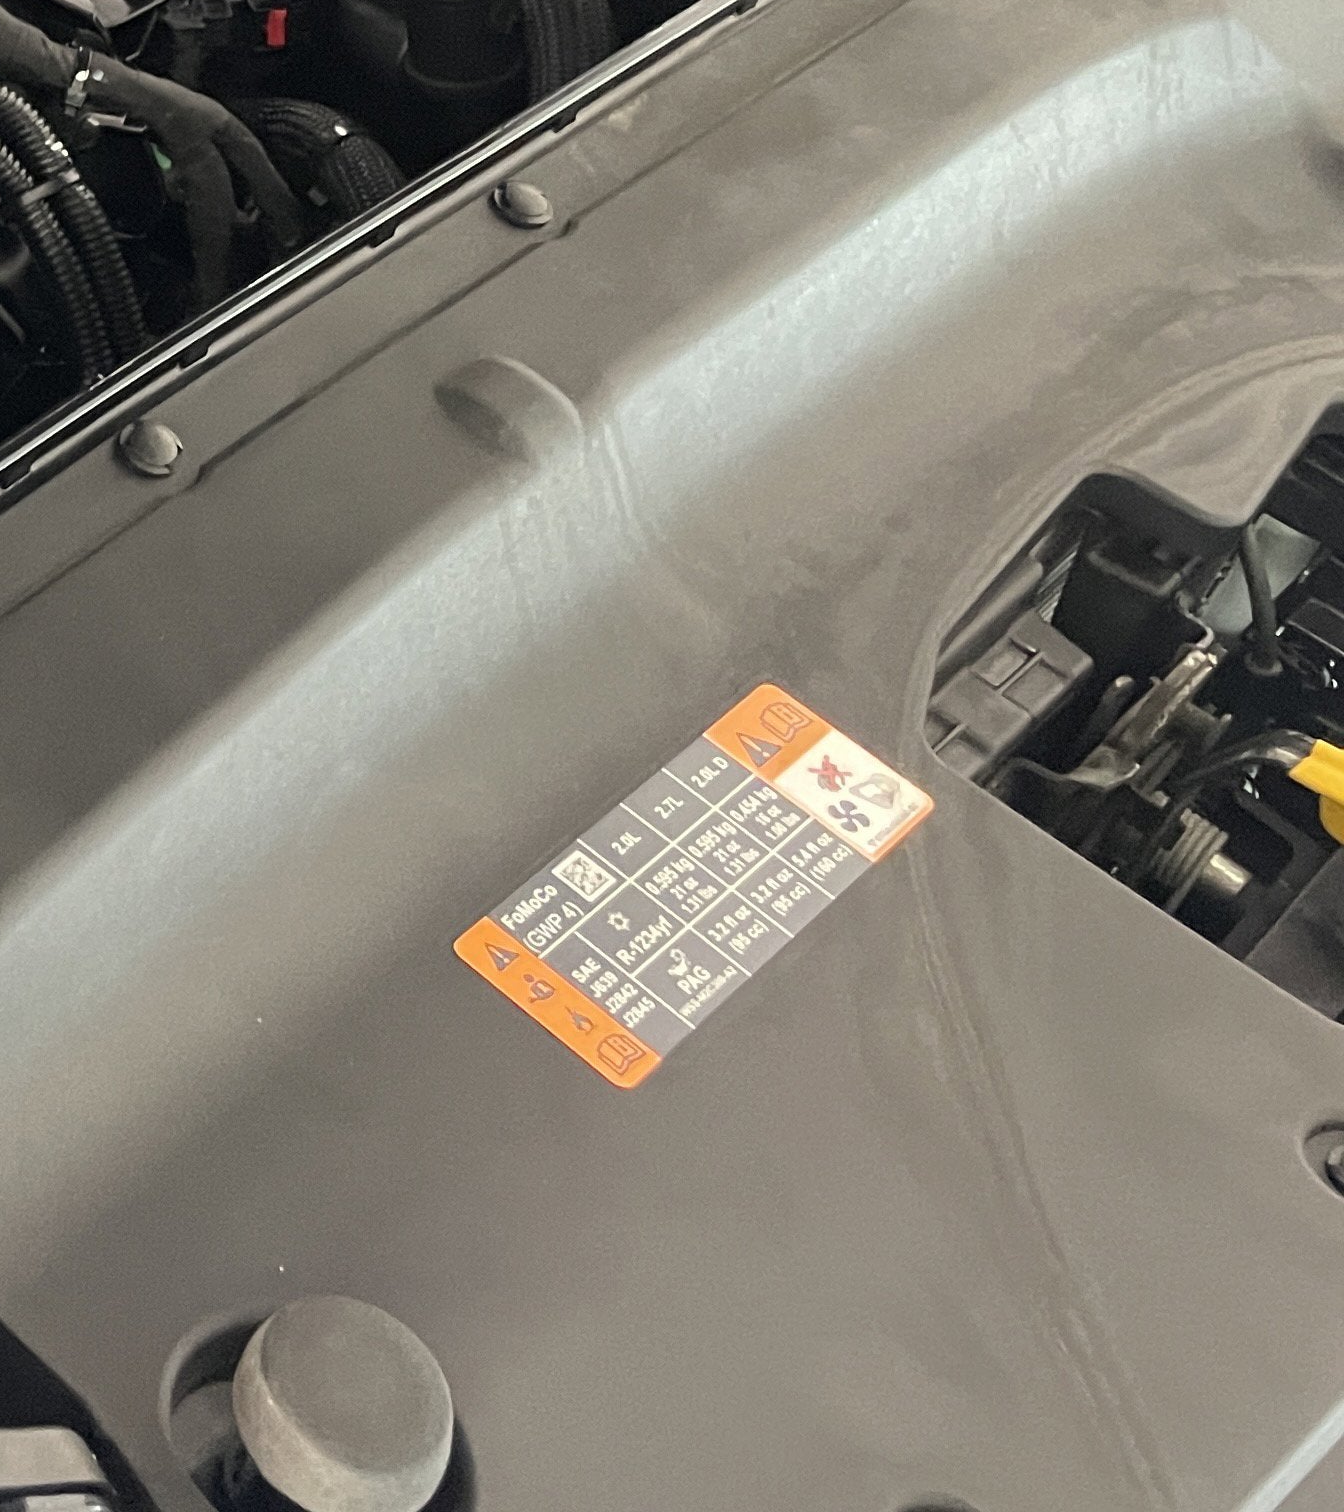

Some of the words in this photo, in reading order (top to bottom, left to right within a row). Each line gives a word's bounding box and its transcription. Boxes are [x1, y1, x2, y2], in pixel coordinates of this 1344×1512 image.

[690, 764, 721, 788] 2.0L
[711, 754, 729, 769] D
[653, 795, 684, 818] 2.7L
[753, 785, 778, 801] kg
[766, 804, 782, 818] oz
[712, 820, 738, 836] kg
[610, 831, 642, 855] 2.0L
[712, 847, 730, 862] 21
[725, 840, 741, 853] oz
[790, 848, 813, 867] 5.4
[815, 832, 833, 847] oz
[670, 856, 695, 872] kg
[669, 883, 687, 900] 21
[683, 876, 699, 890] oz
[749, 884, 772, 904] 3.2
[776, 867, 794, 883] oz
[499, 881, 559, 930] FoMoCo
[521, 912, 568, 953] (GWP
[558, 900, 585, 919] 4)
[707, 921, 730, 941] 3.2
[733, 905, 751, 920] oz
[570, 957, 602, 984] SAE
[587, 970, 619, 998] J639
[676, 964, 711, 994] PAG
